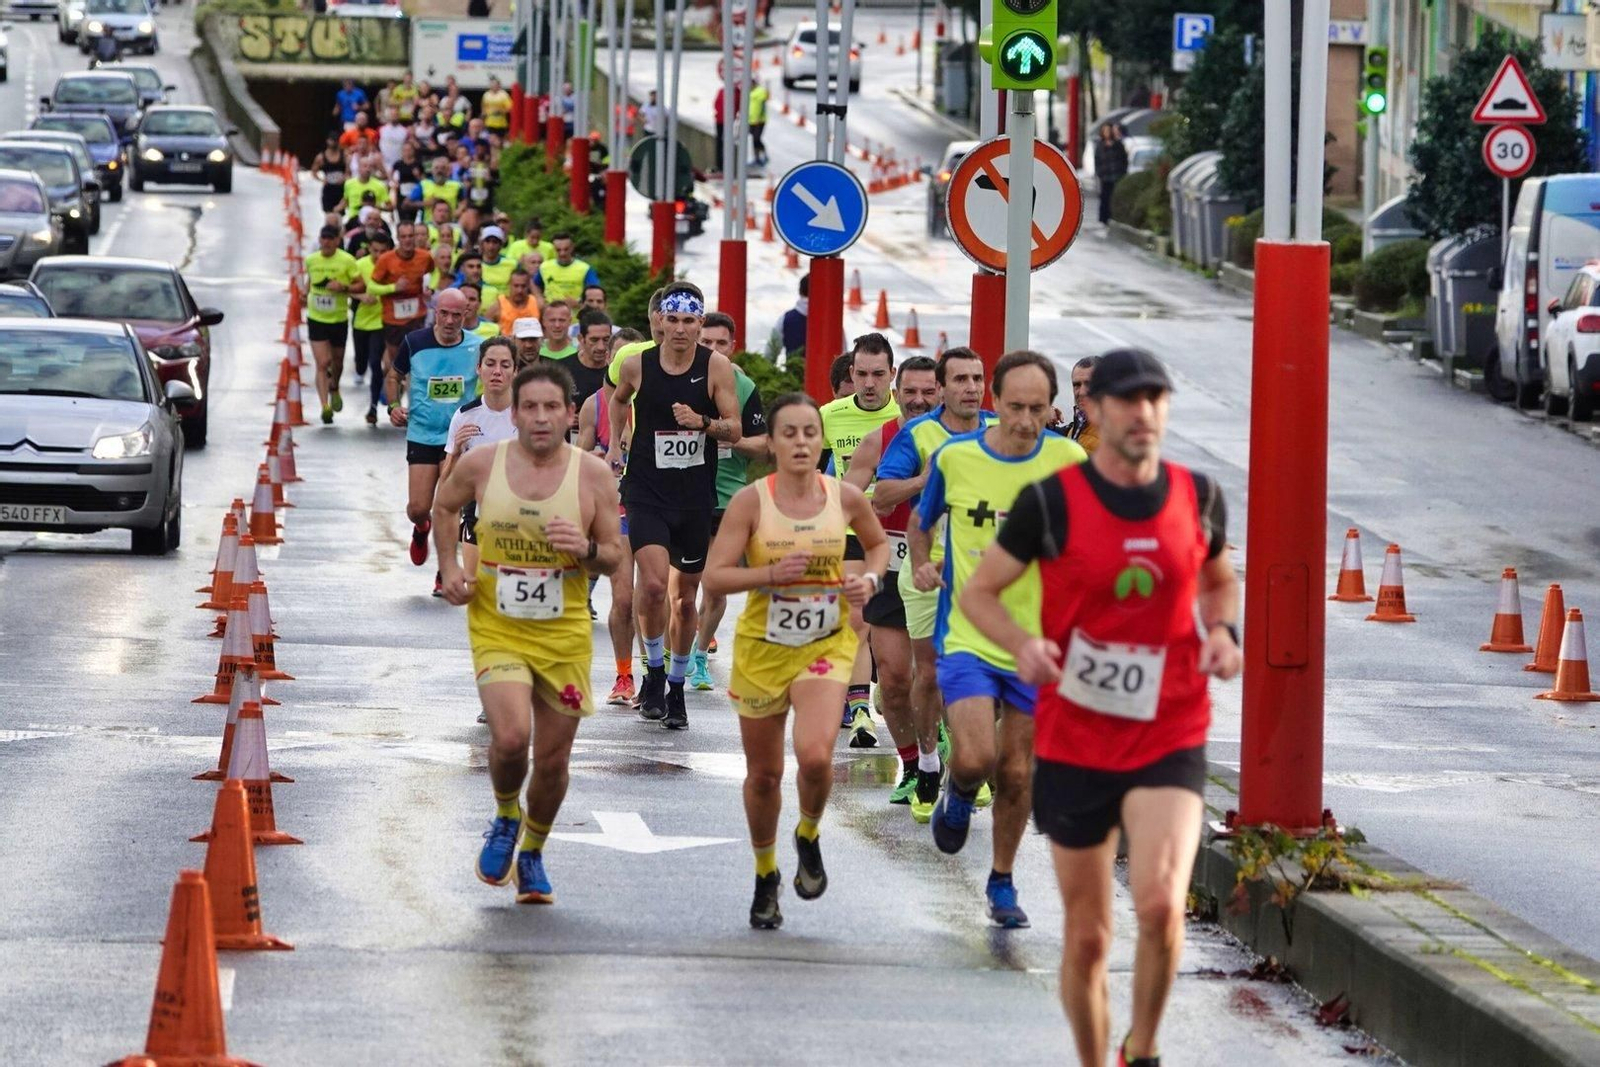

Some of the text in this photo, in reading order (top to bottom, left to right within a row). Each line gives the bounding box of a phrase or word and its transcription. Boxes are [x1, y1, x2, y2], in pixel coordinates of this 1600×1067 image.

[1183, 19, 1206, 47] P
[1497, 142, 1523, 159] 30
[434, 383, 458, 395] 524
[664, 440, 698, 456] 200
[1, 506, 60, 522] 540 FFX
[515, 581, 547, 603] 54
[778, 608, 825, 630] 261
[1077, 655, 1145, 694] 220
